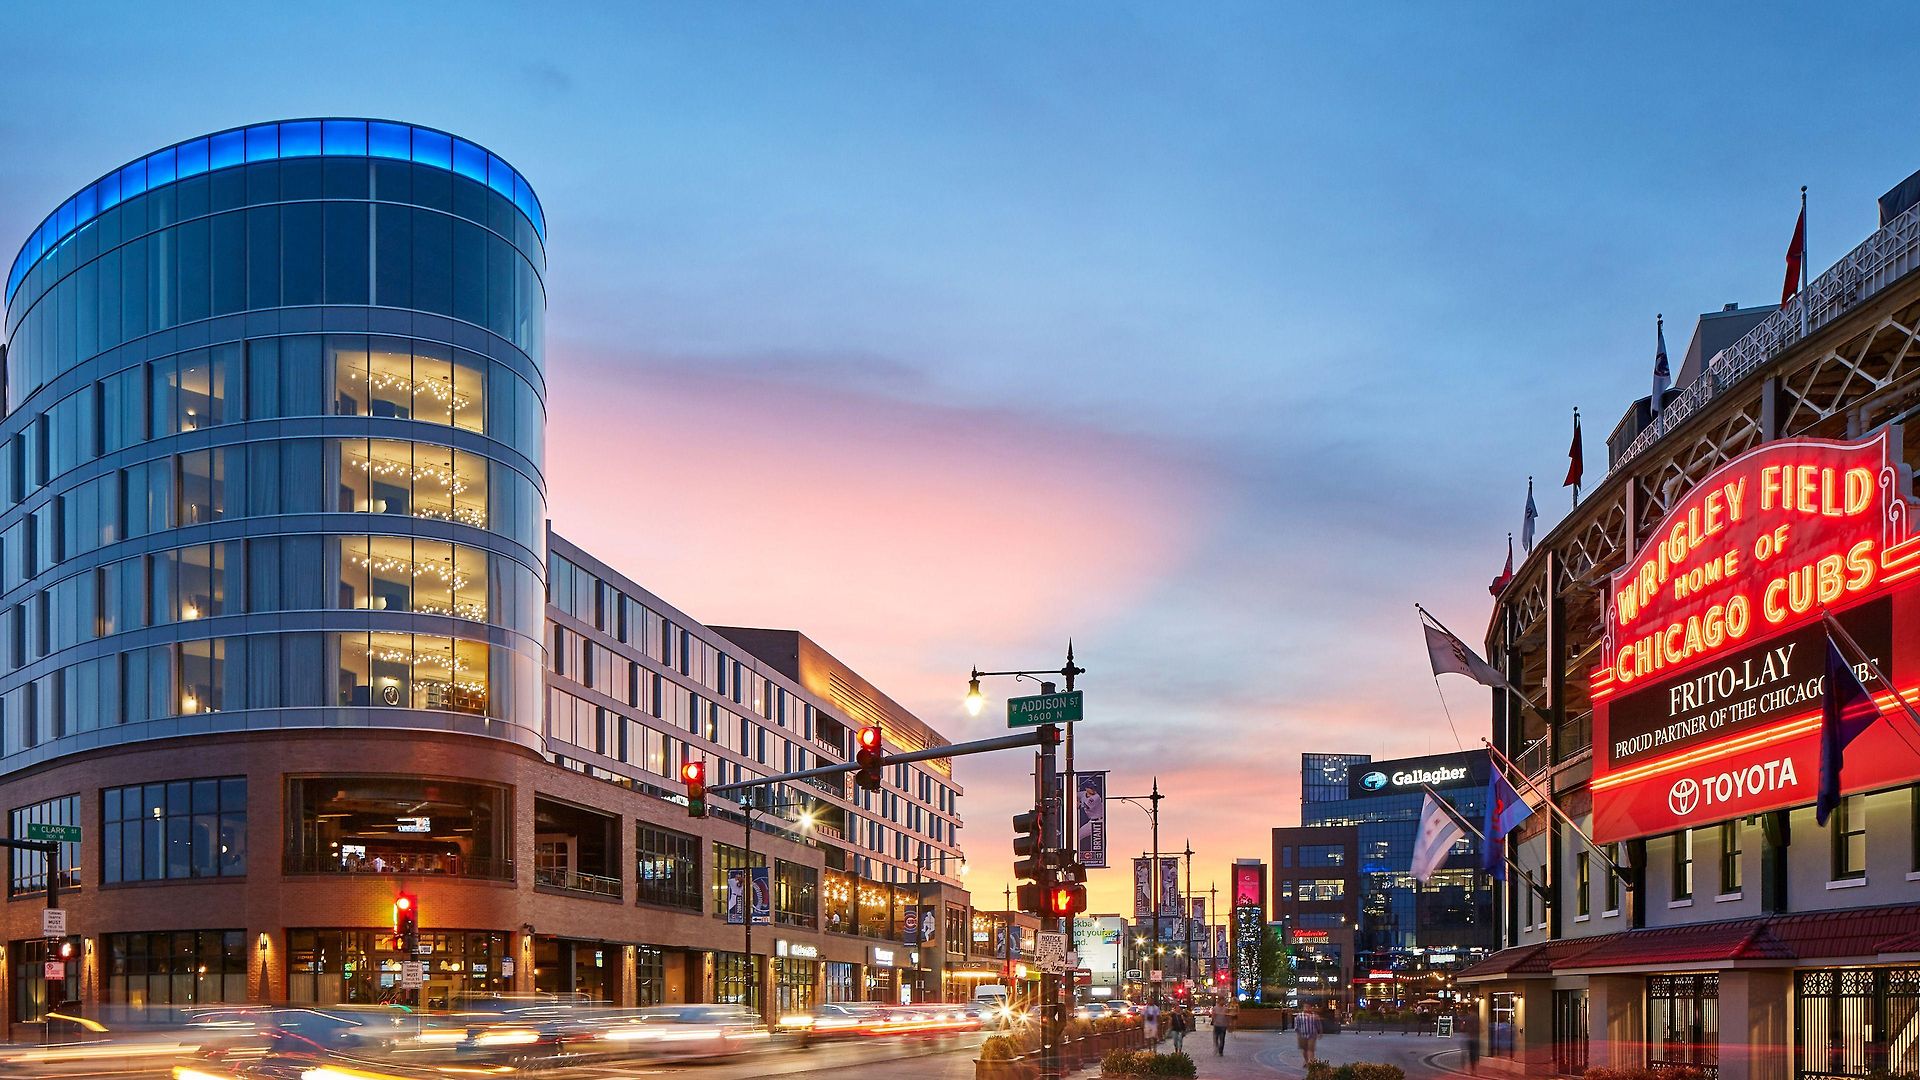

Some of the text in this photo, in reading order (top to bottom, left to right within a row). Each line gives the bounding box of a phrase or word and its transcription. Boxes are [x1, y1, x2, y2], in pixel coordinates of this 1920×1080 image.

[1617, 464, 1875, 626] WRIGLEY FIELD
[1674, 523, 1790, 601] HOME OF
[1616, 540, 1877, 683] CHICAGO CUBS
[1669, 643, 1796, 717] FRITO-LAY
[1020, 697, 1067, 713] ADDISON
[1027, 710, 1063, 722] 3600 N
[1615, 732, 1653, 759] PROUD
[1654, 714, 1708, 747] PARTNER
[1709, 707, 1728, 729] OF
[1728, 697, 1757, 723] THE
[1392, 766, 1467, 786] Gallagher
[1702, 757, 1798, 805] TOYOTA
[41, 826, 66, 834] CLARK
[1092, 823, 1102, 850] BRYANT
[1095, 852, 1102, 860] 17
